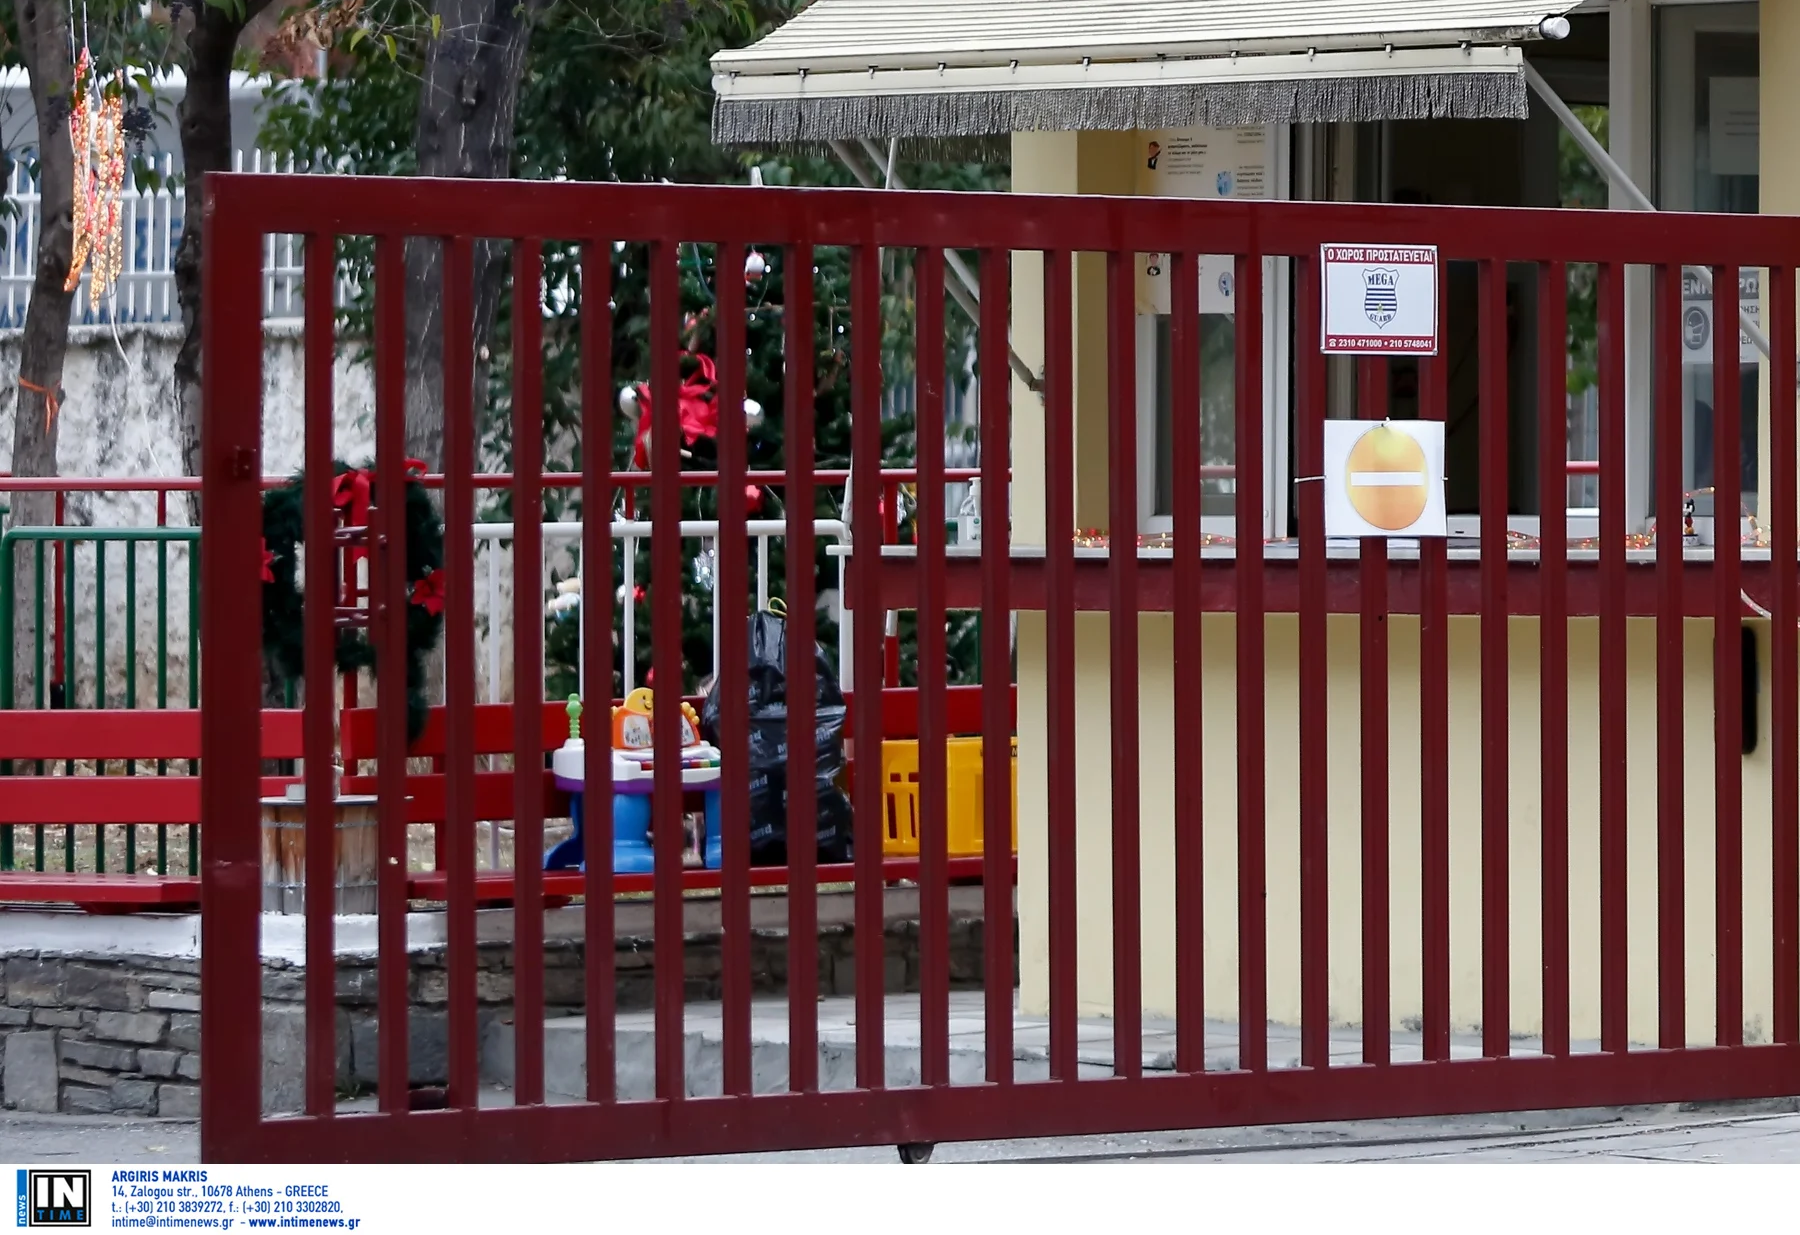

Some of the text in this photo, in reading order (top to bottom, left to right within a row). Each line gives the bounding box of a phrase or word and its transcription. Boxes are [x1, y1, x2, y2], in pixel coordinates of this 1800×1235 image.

[1328, 249, 1433, 262] Ο ΧΩΡΟΣ ΠΡΟΣΤΑΤΕΥΕΤΑΙ
[1368, 273, 1394, 285] MEGA
[1369, 313, 1392, 322] GUARD
[1339, 339, 1432, 348] 2310 471000 210 5748041
